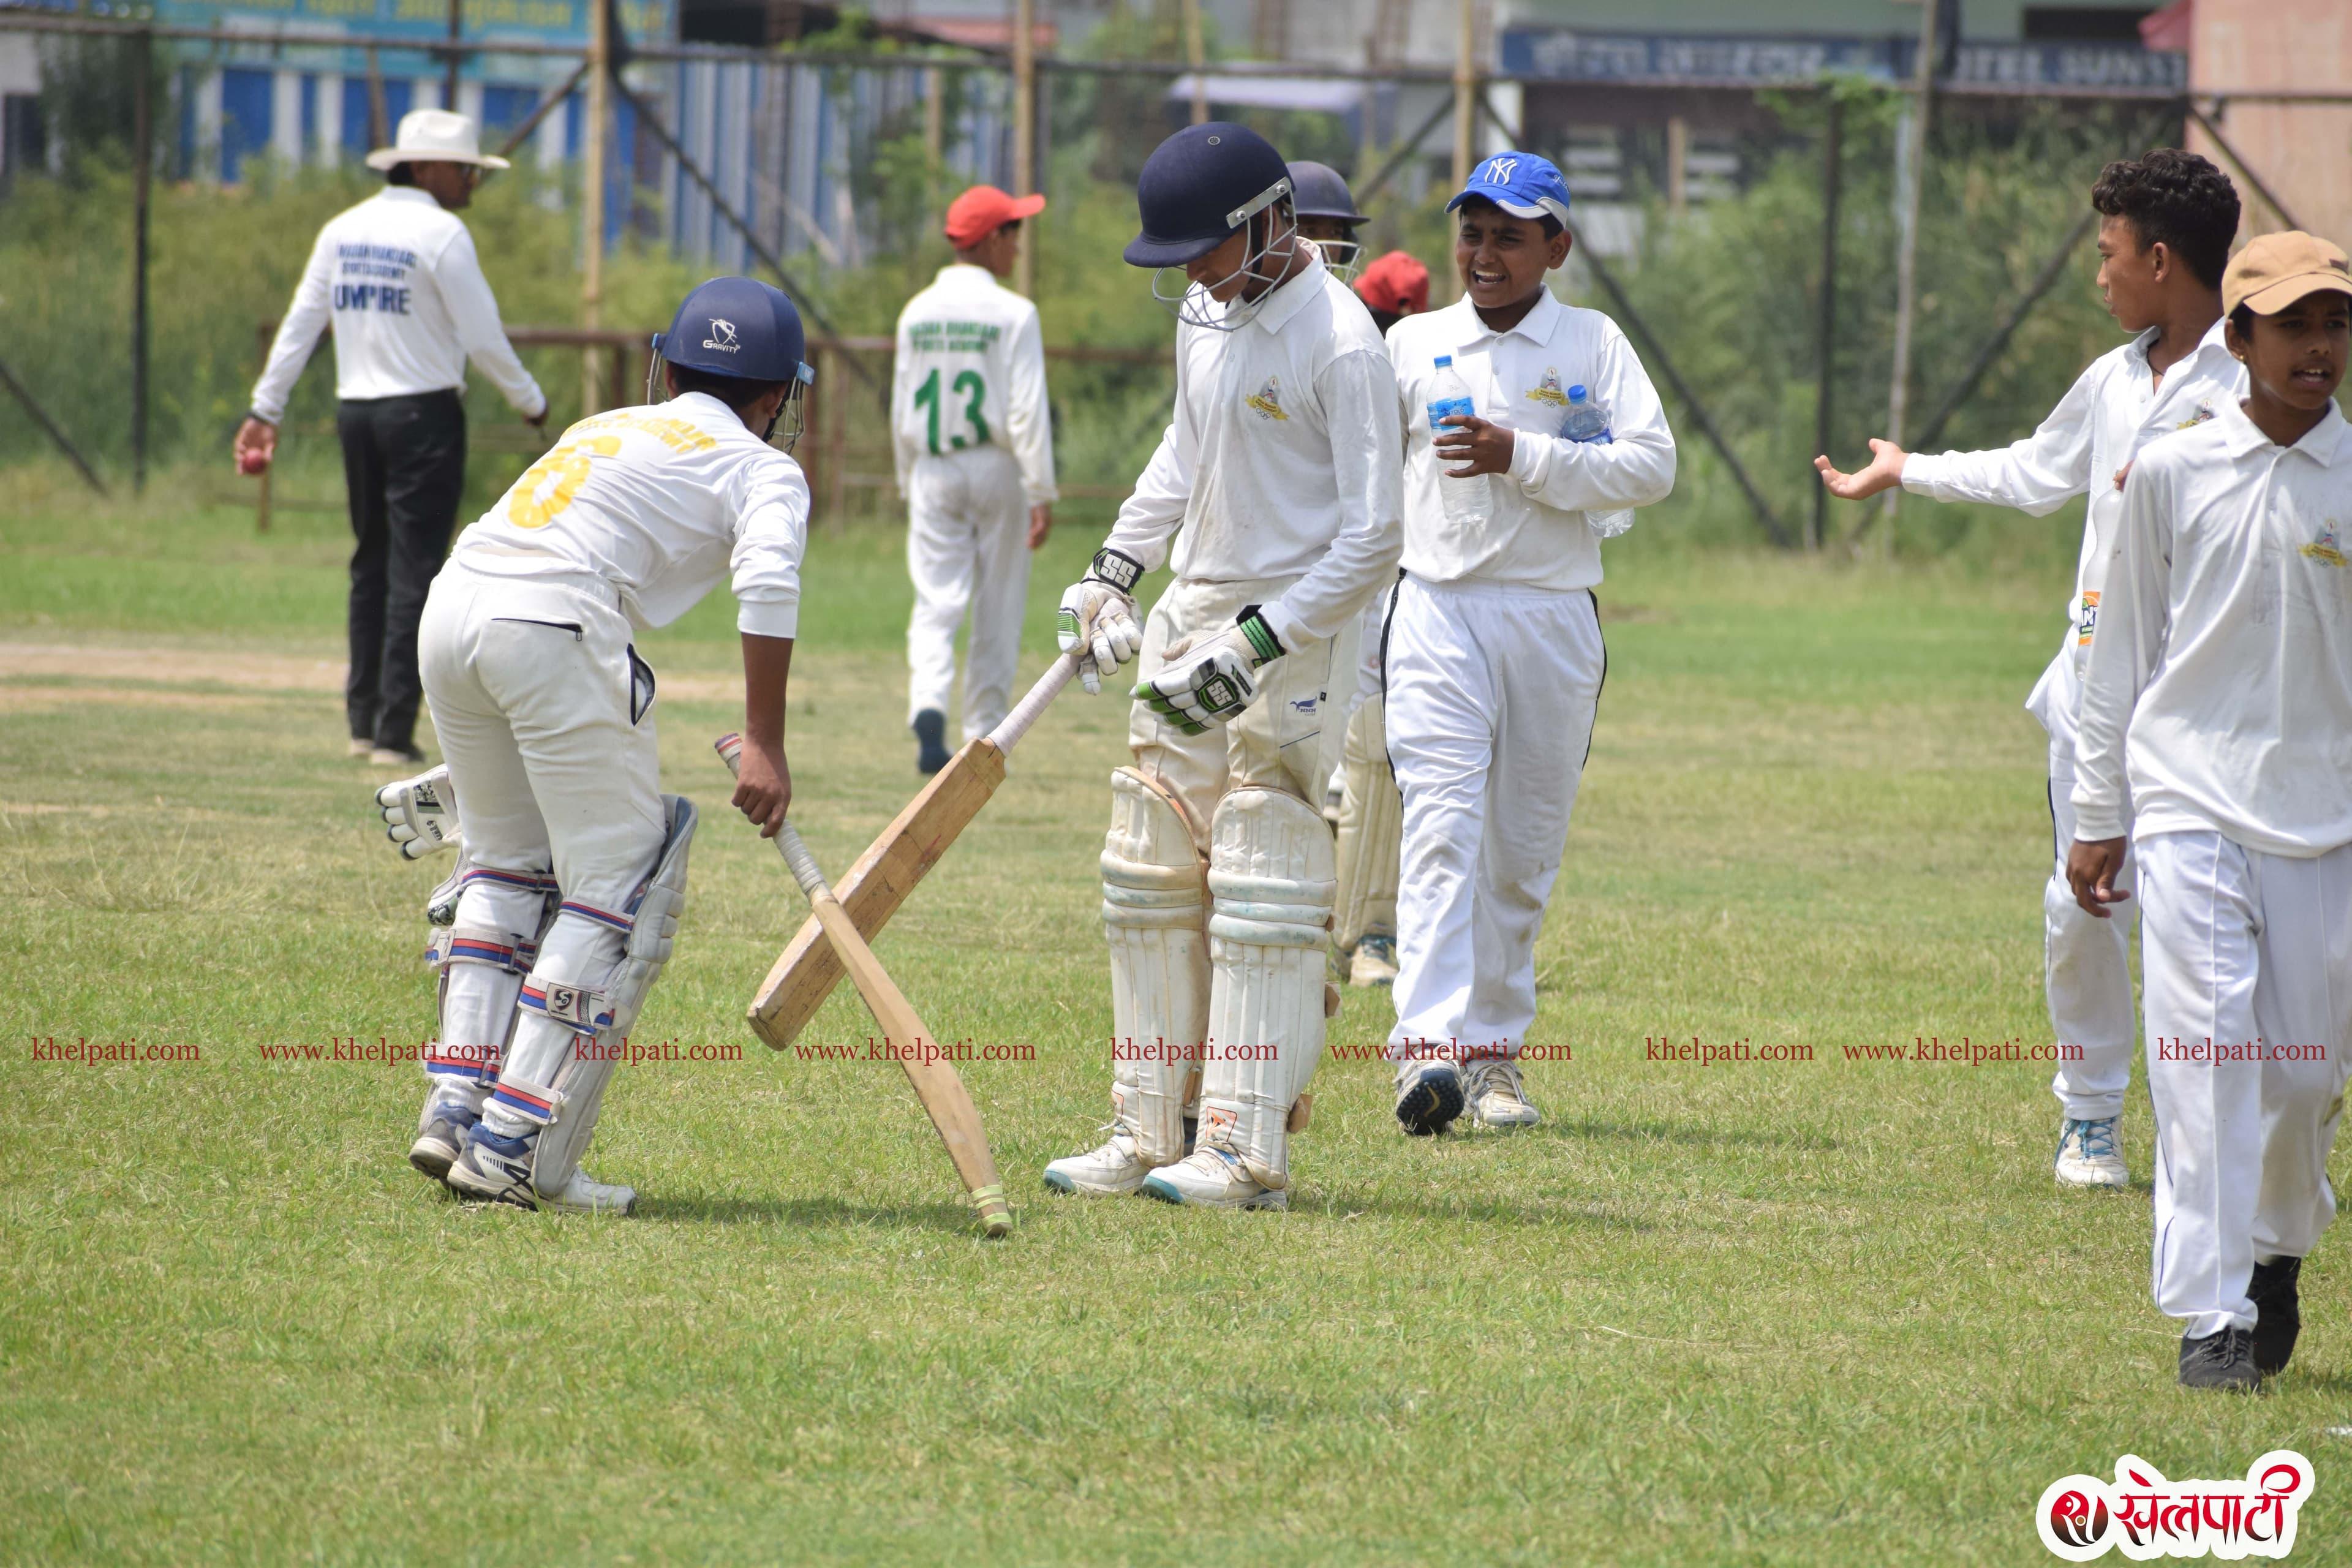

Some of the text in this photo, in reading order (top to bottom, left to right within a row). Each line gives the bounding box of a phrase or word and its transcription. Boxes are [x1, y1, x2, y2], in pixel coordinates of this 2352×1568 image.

[1485, 157, 1518, 185] NY
[334, 284, 411, 316] UMPIRE
[703, 339, 739, 353] GRAVITY
[914, 368, 991, 456] 13
[1099, 553, 1137, 589] SS
[1206, 680, 1233, 707] SS
